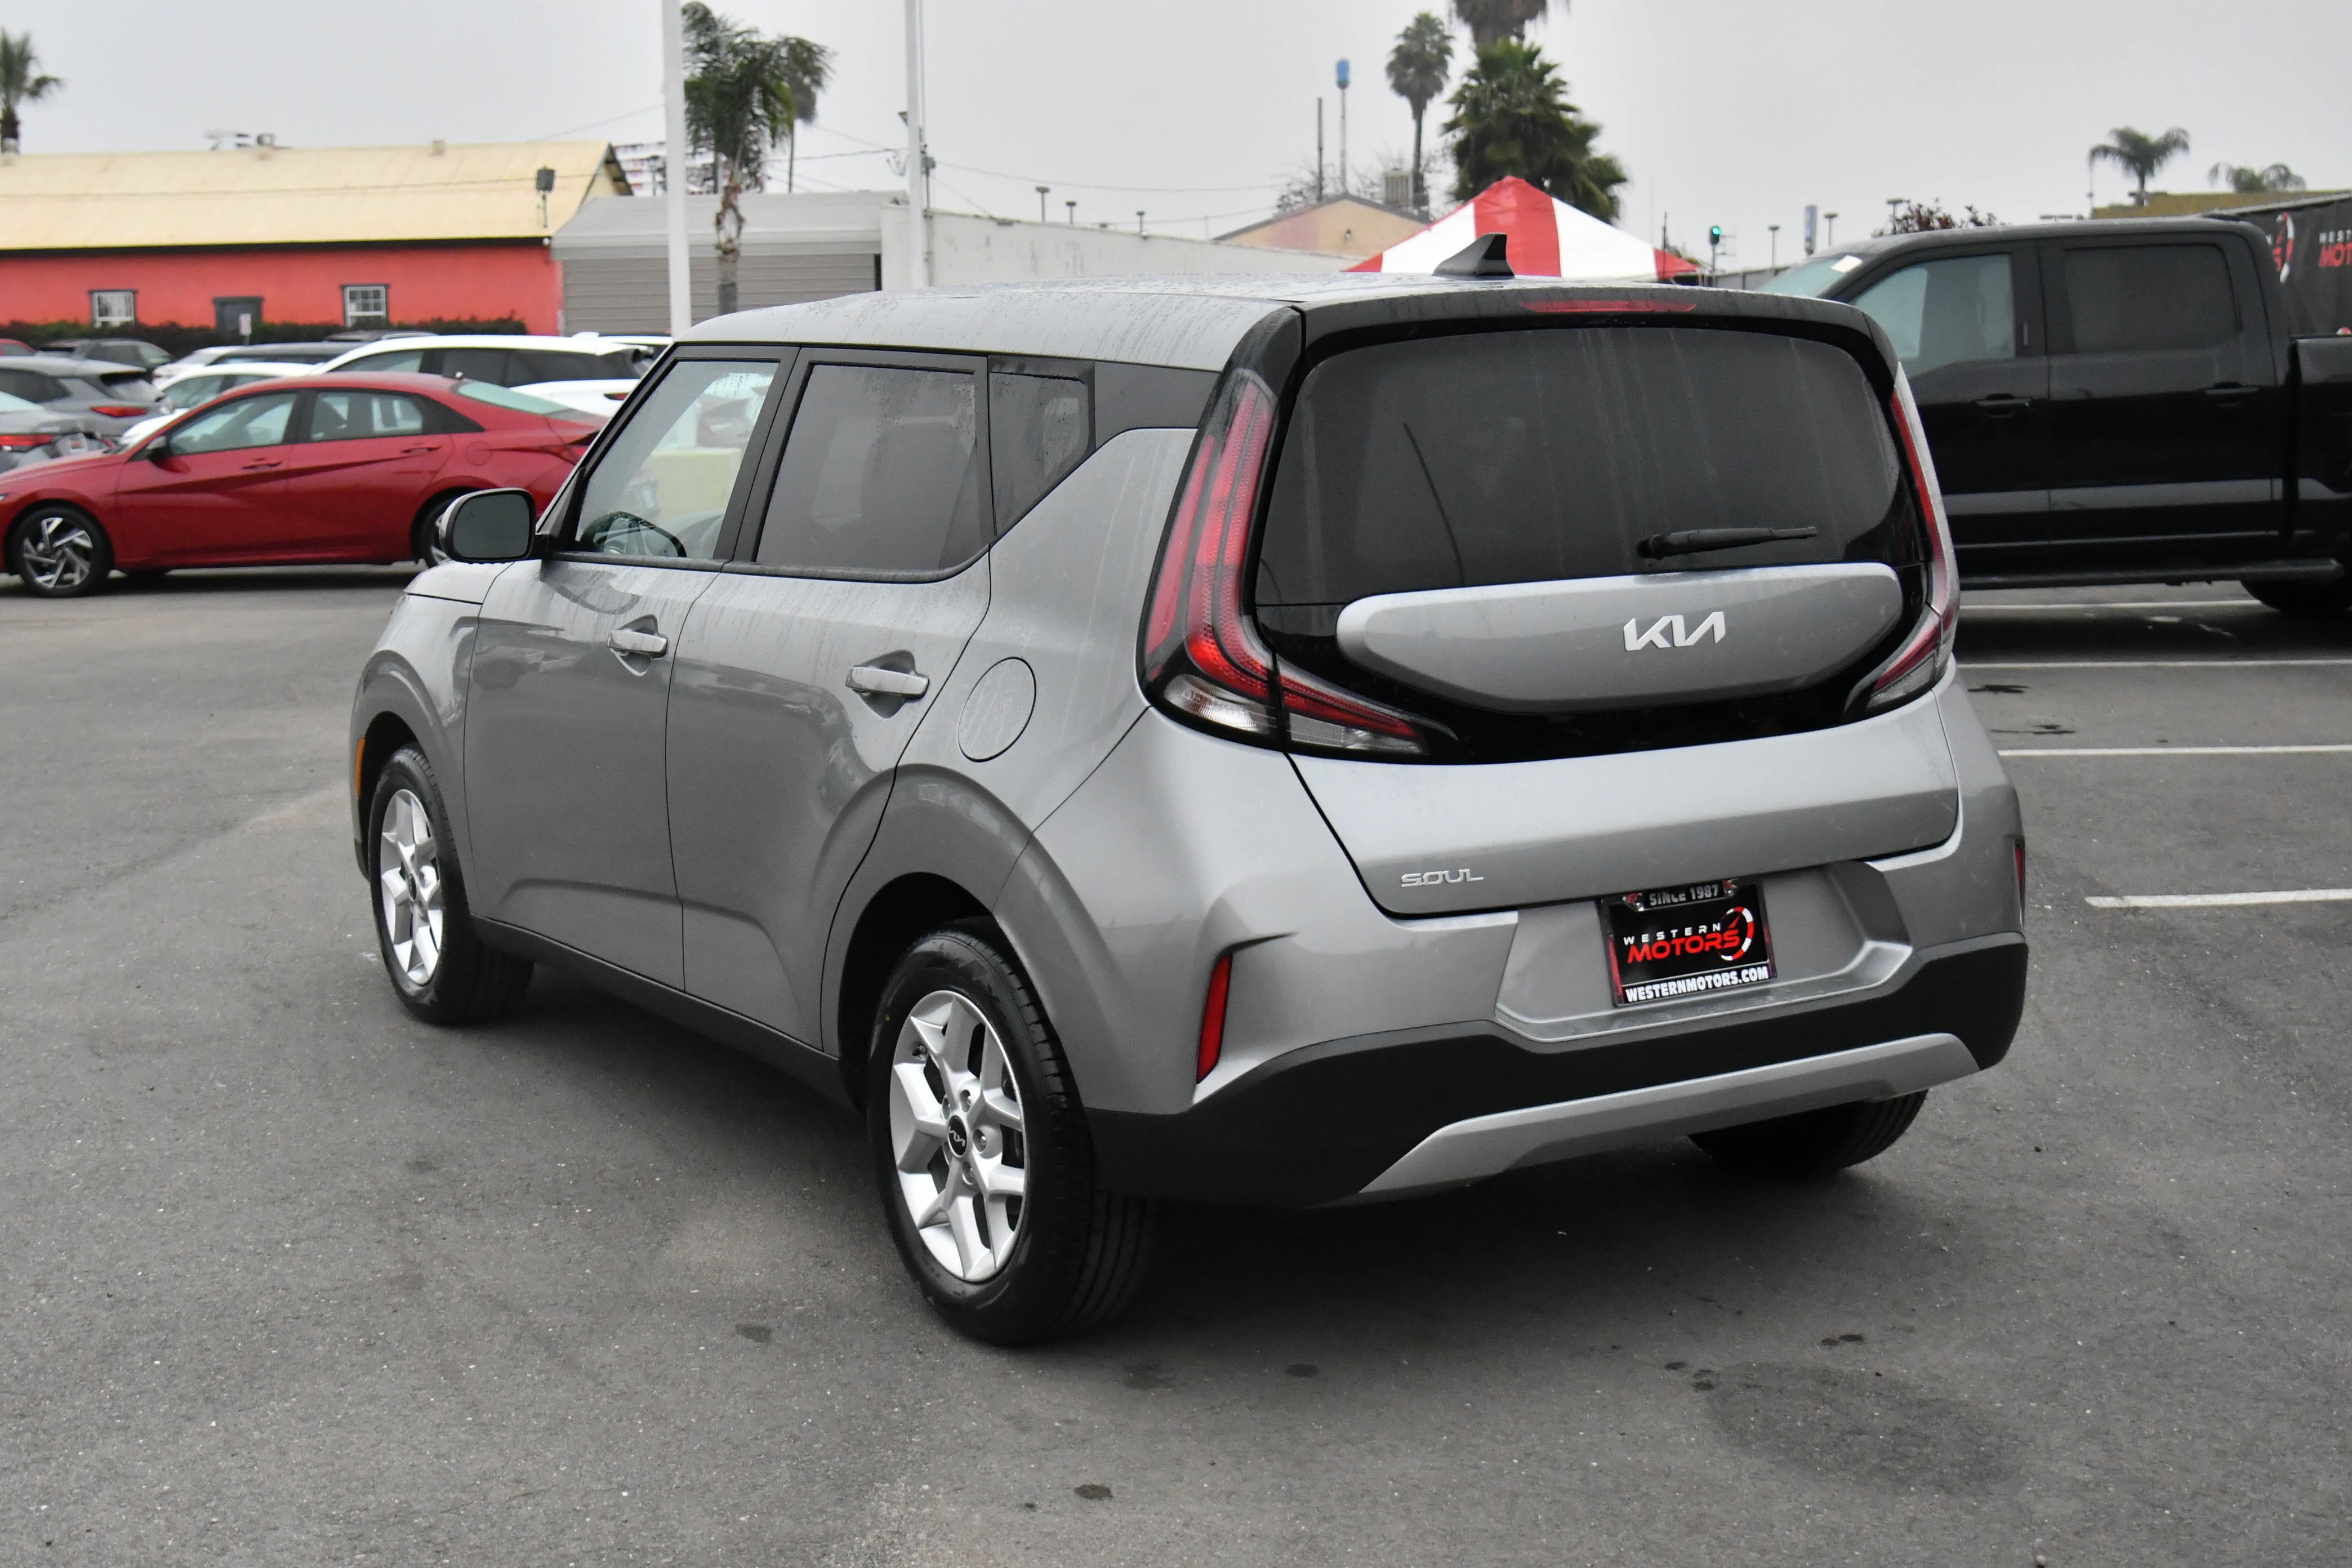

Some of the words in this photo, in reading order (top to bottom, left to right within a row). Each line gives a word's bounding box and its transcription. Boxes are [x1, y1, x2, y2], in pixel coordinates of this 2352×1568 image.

[1623, 611, 1726, 651] KIA
[1401, 868, 1484, 888] SOUL
[1690, 884, 1719, 900] 1987
[1623, 922, 1721, 946] WESTERN
[1627, 929, 1740, 964] MOTORS
[1625, 965, 1769, 1003] WESTERNMOTORS.COM
